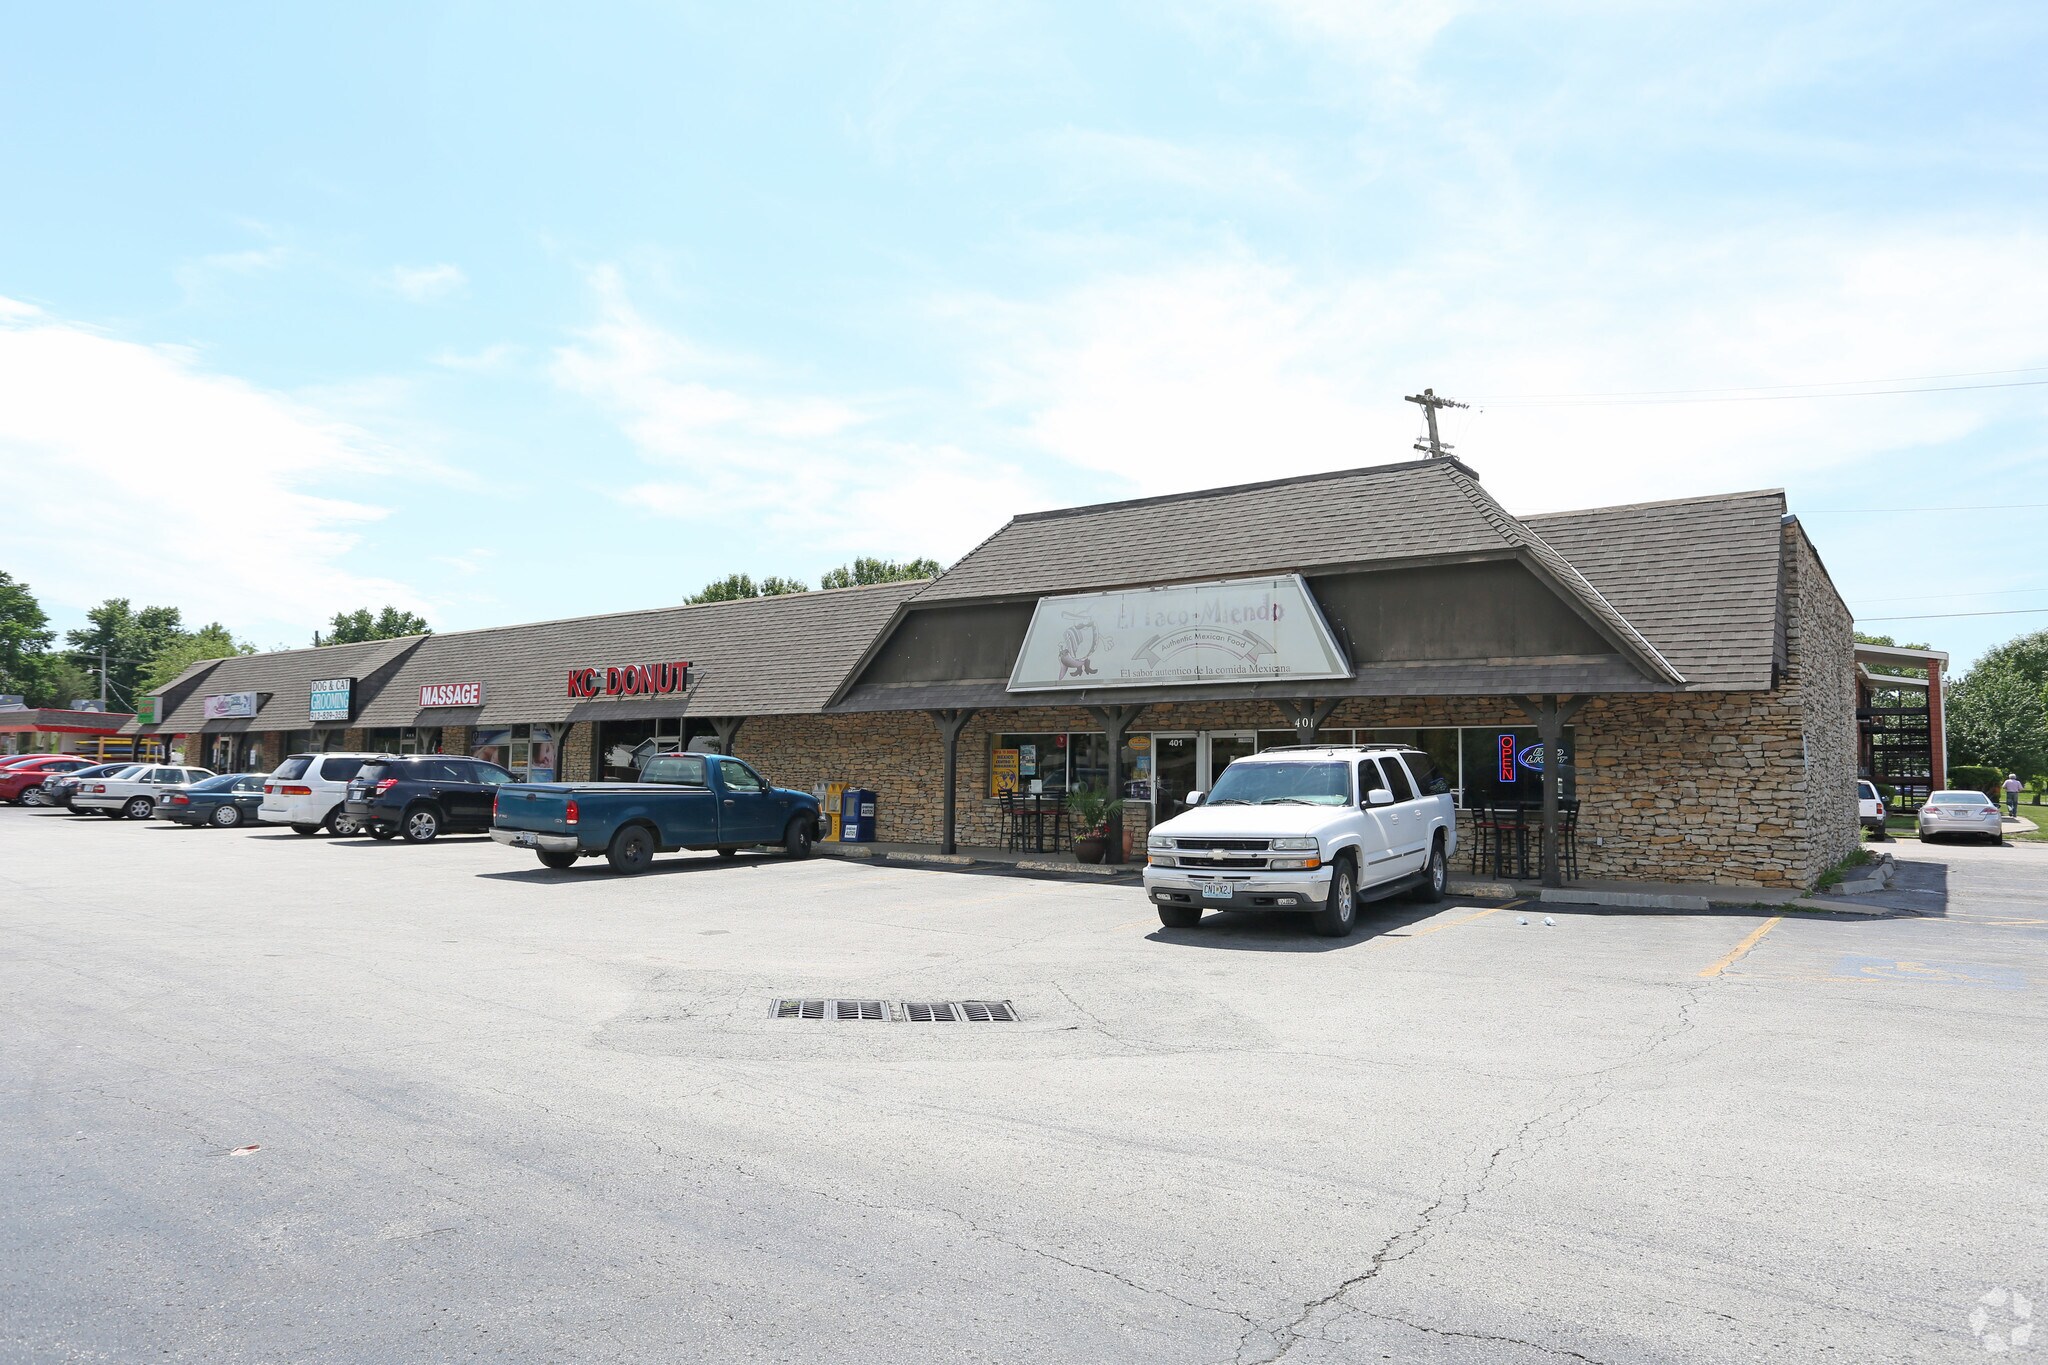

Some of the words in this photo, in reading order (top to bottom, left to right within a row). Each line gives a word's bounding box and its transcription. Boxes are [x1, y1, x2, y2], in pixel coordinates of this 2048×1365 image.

[1161, 633, 1193, 651] Authentic
[1194, 632, 1225, 642] Mexican
[1227, 636, 1247, 648] Food
[1120, 668, 1131, 677] El
[1132, 667, 1154, 677] sabor
[1155, 666, 1193, 677] autentico
[1195, 665, 1204, 675] de
[1205, 664, 1214, 674] la
[1215, 664, 1247, 674] comida
[1249, 662, 1291, 674] Mexicana
[312, 681, 327, 692] DOG
[329, 681, 334, 691] &
[336, 680, 349, 690] CAT
[567, 667, 598, 698] KC
[606, 661, 689, 696] DONUT
[311, 691, 349, 710] GROOMING
[421, 684, 479, 706] MASSAGE
[1295, 718, 1314, 729] 401
[1168, 739, 1183, 748] 401
[1501, 736, 1513, 780] OPEN
[1526, 756, 1568, 764] LIGT
[1533, 748, 1564, 757] BD
